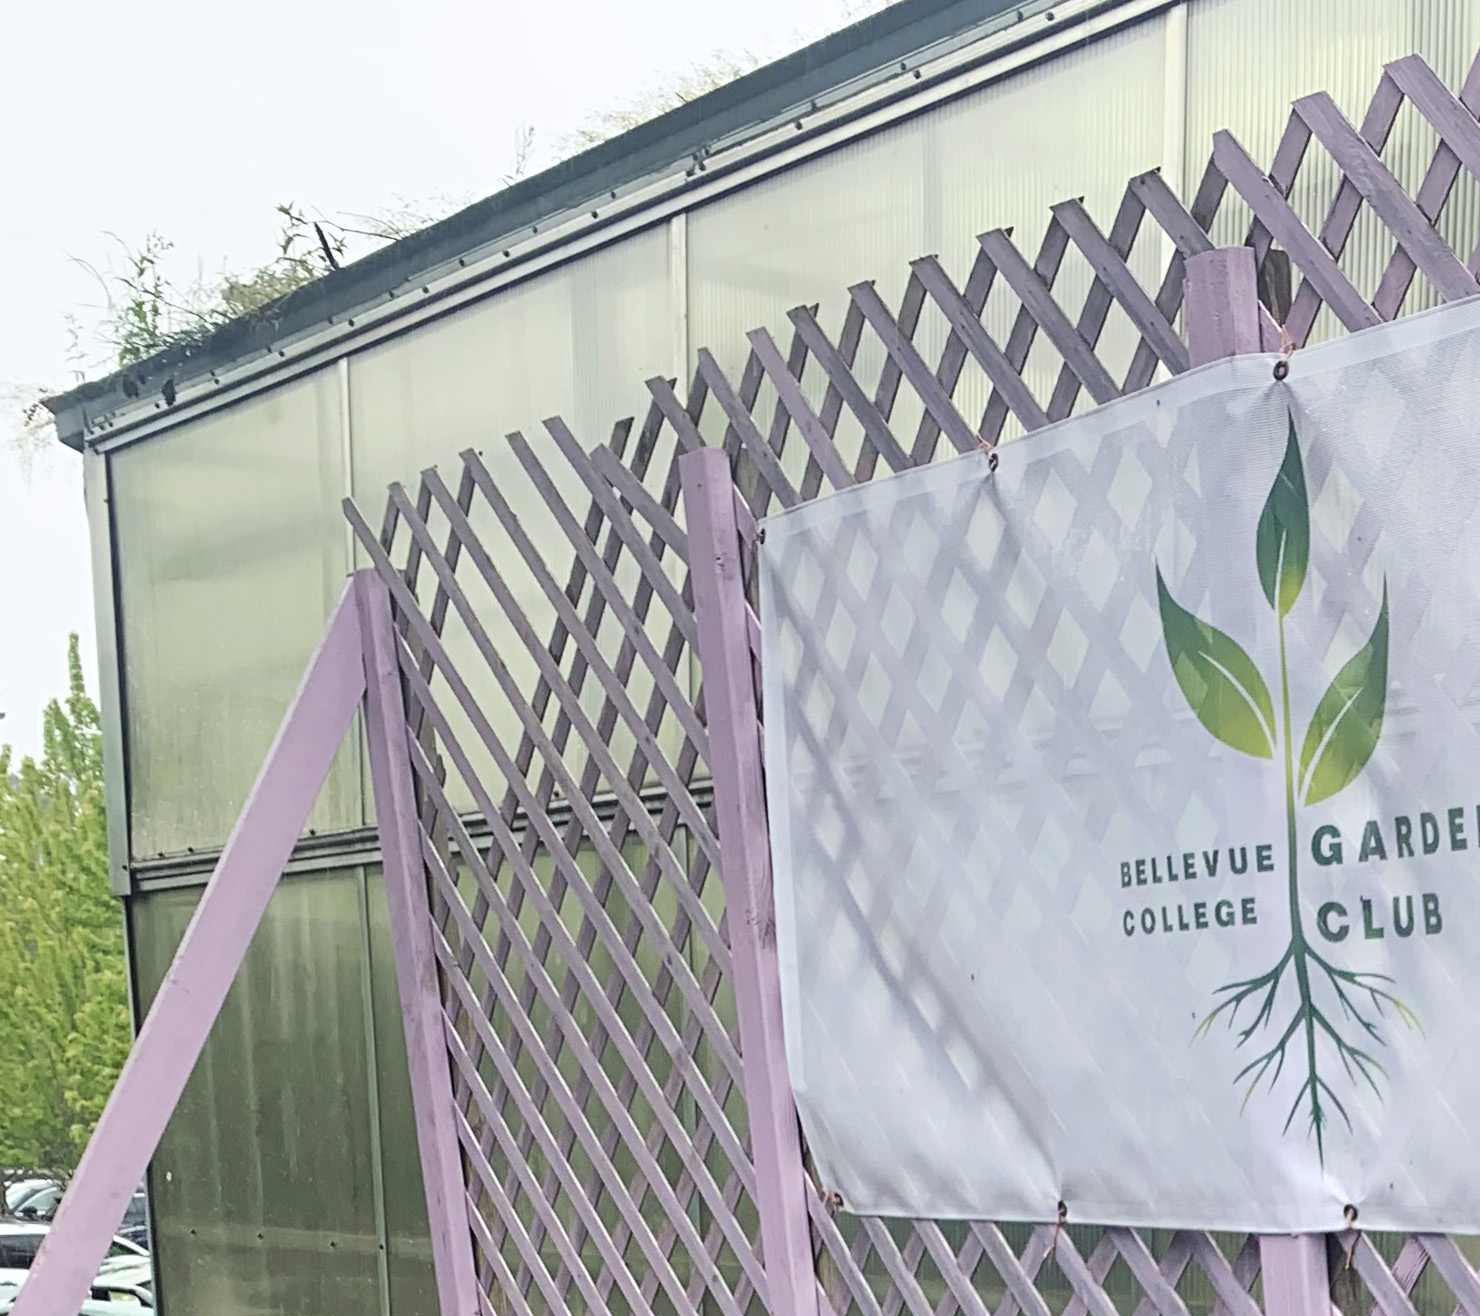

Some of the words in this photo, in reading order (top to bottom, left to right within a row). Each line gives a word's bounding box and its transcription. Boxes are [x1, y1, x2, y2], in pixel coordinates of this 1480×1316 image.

[1119, 844, 1275, 888] BELLEVUE
[1123, 897, 1258, 937] COLLEGE
[1317, 892, 1444, 943] CLUB
